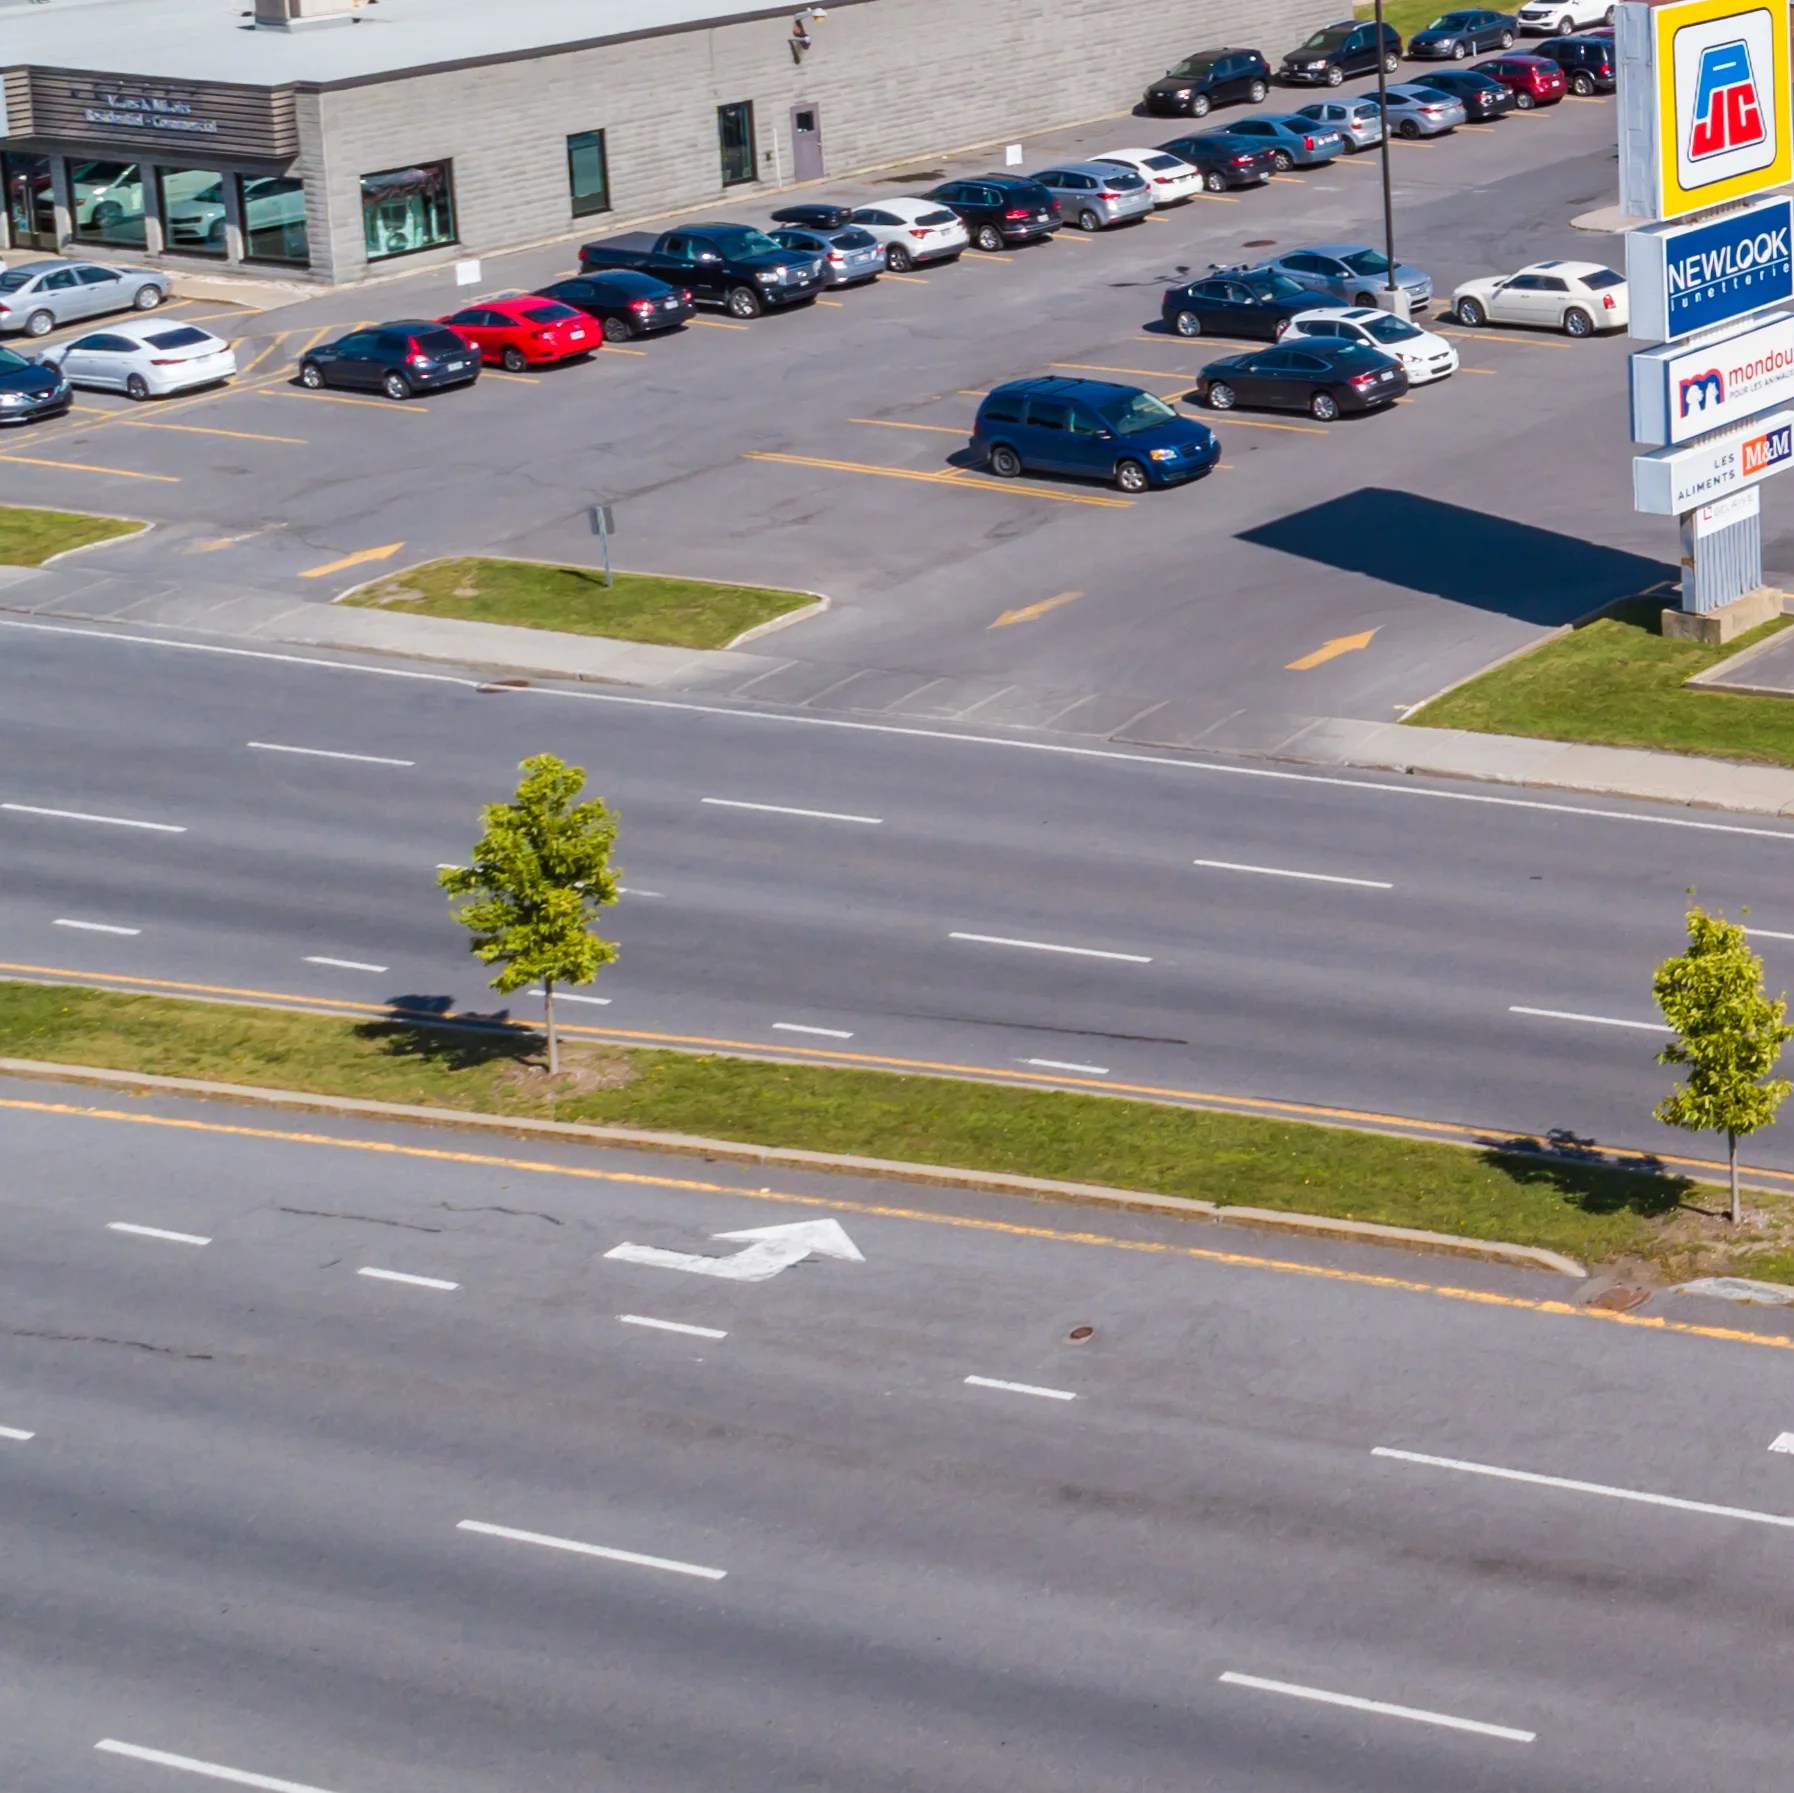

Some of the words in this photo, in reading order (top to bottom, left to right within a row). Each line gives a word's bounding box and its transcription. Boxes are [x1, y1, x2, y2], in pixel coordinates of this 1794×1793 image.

[1670, 262, 1790, 312] lunetterie
[1729, 347, 1793, 387] mondou
[1729, 386, 1748, 399] POUR
[1751, 380, 1762, 392] LES
[1765, 368, 1794, 386] ANIMAUX
[1714, 453, 1735, 469] LES
[1745, 430, 1790, 470] M&M
[1678, 469, 1736, 500] ALIMENTS
